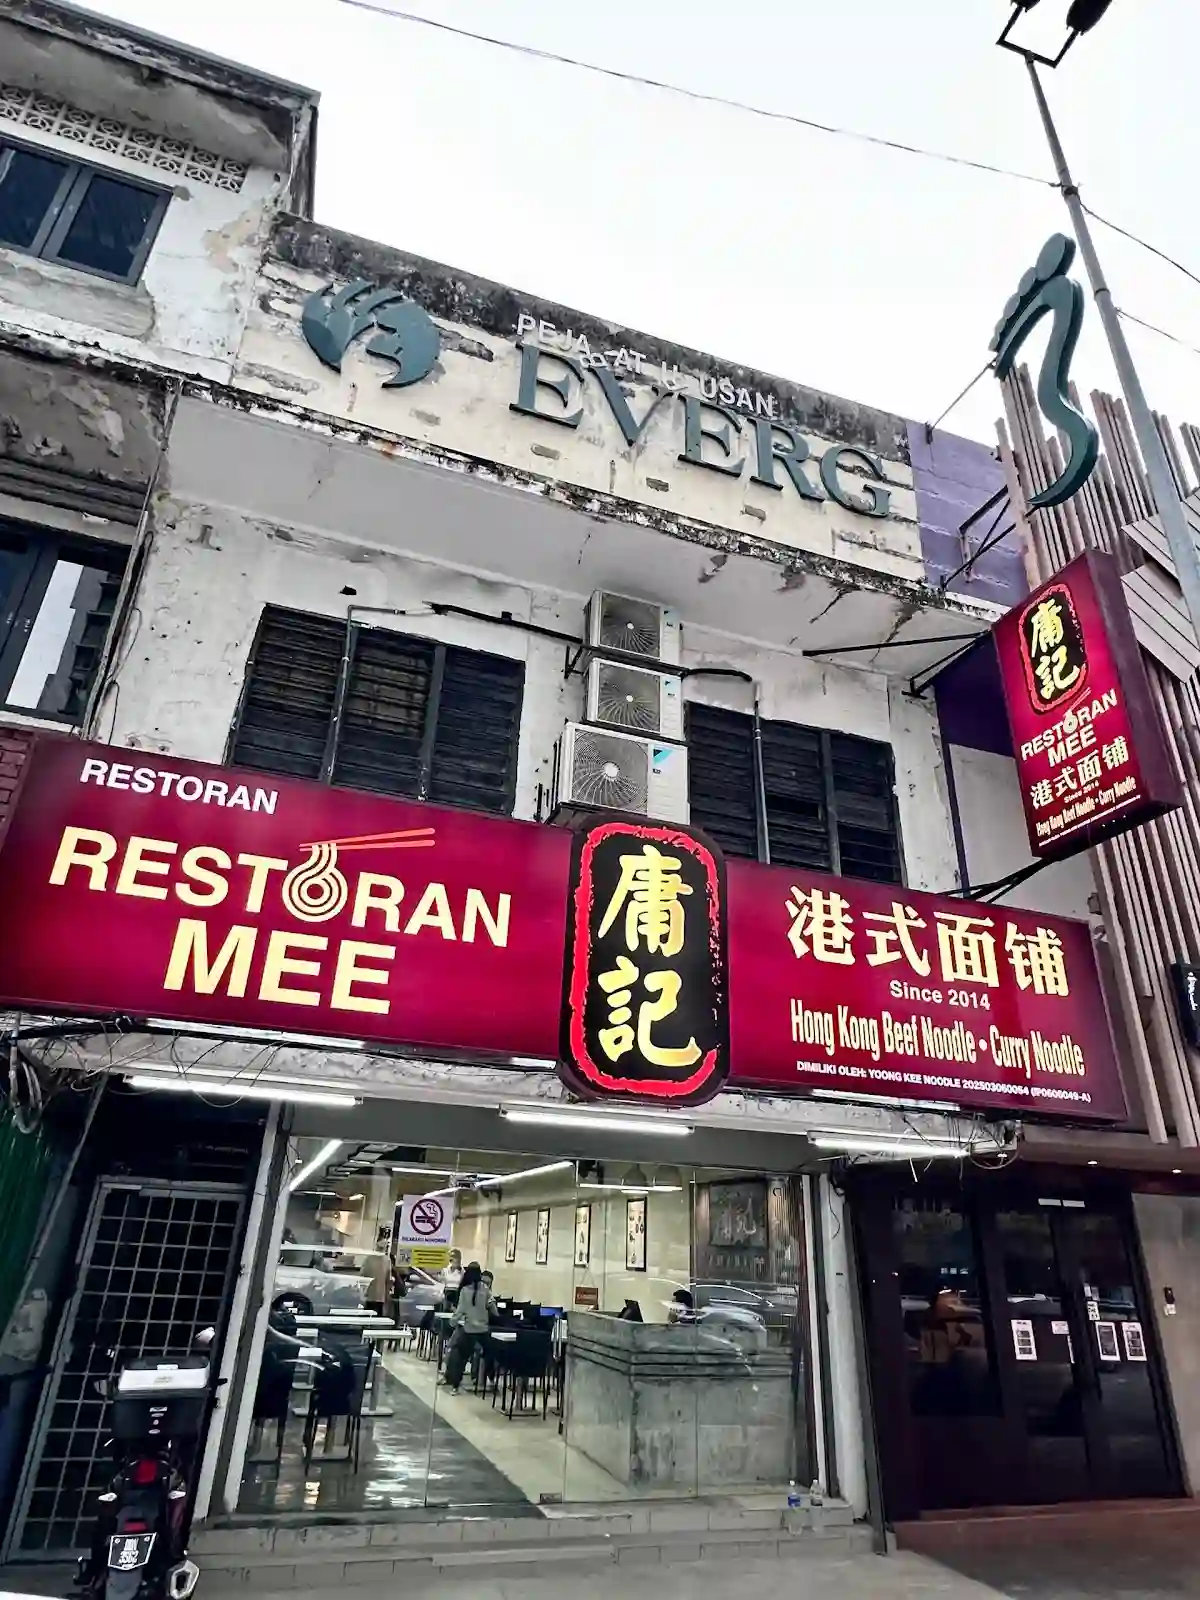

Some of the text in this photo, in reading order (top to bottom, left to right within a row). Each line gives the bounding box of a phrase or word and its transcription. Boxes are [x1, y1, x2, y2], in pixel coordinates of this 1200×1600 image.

[509, 343, 892, 518] EVERG
[1020, 688, 1118, 761] RESTORAN
[1047, 723, 1098, 768] MEE
[80, 758, 279, 815] RESTORAN
[1030, 735, 1129, 810] 港式面铺
[49, 825, 512, 948] RESTORAN
[163, 917, 397, 1015] MEE
[784, 885, 1070, 997] 港式面铺
[889, 979, 991, 1011] Since 2014
[790, 998, 1086, 1079] Hong Kong Beef Noodle Curry Noodle
[796, 1060, 837, 1075] DIMILIKI
[838, 1065, 868, 1078] OLEH:
[868, 1068, 903, 1082] YOONG
[903, 1074, 923, 1084] KEE
[923, 1074, 962, 1089] NOODLE
